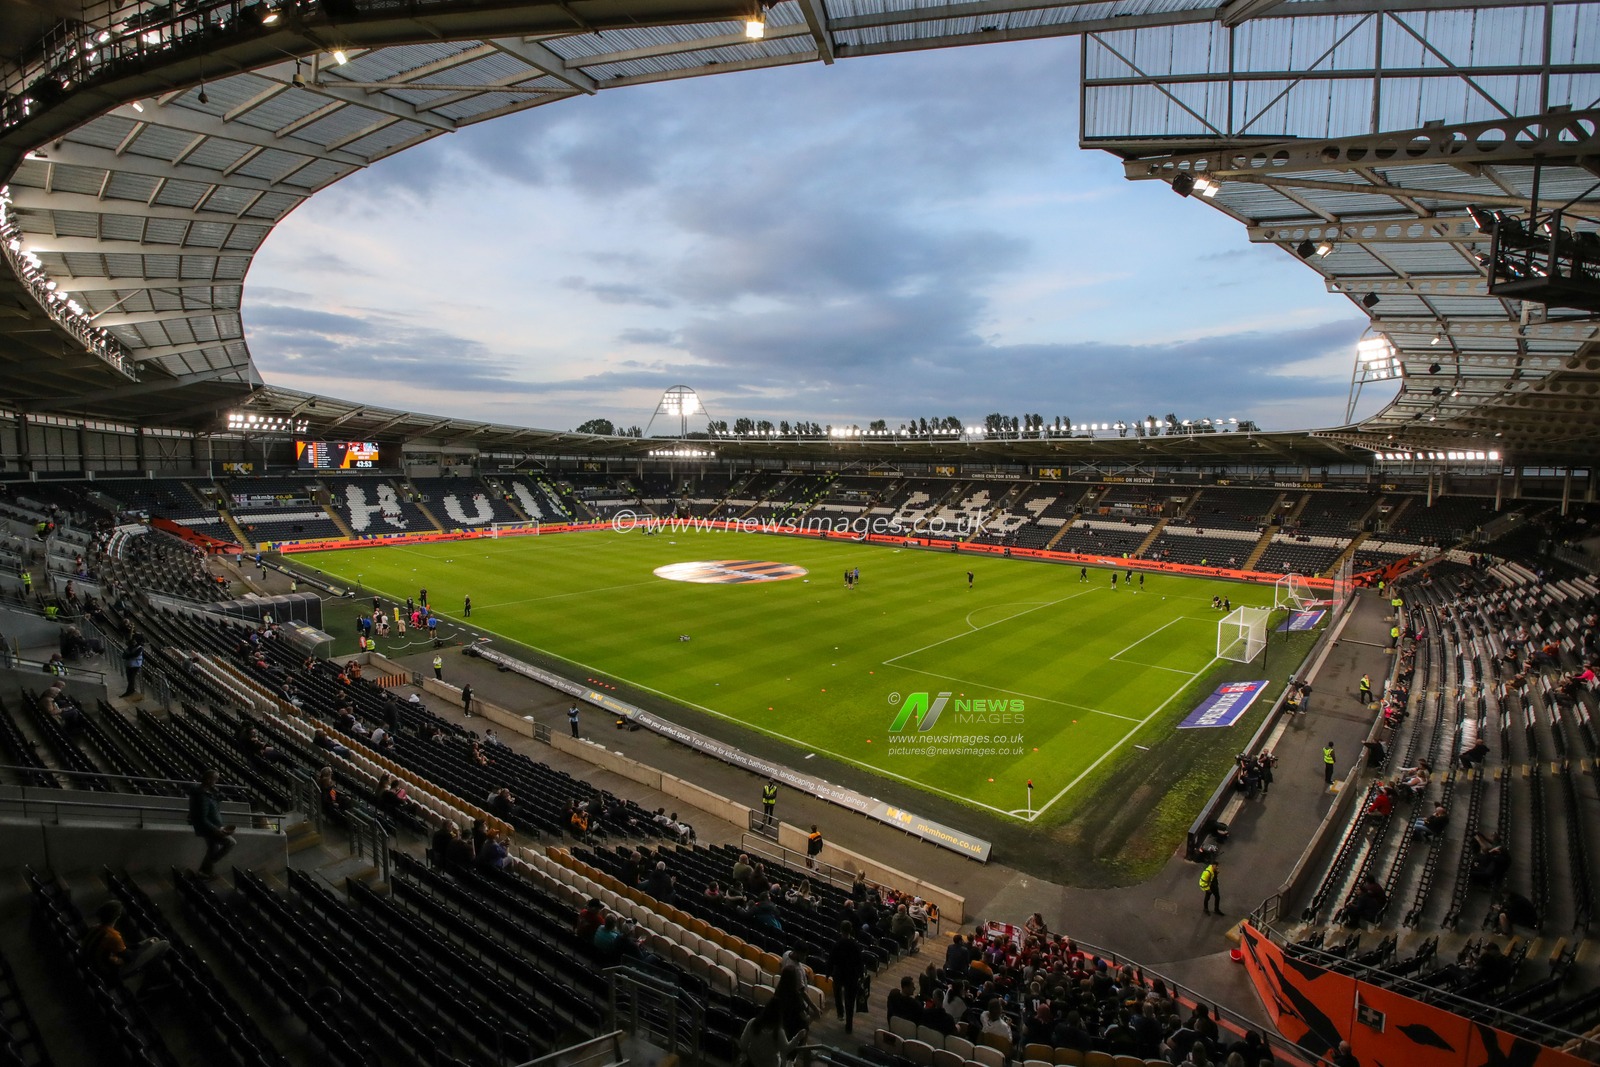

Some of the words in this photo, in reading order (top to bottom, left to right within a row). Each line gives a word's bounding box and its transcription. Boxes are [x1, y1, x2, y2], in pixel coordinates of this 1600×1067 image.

[223, 462, 253, 474] MKM
[936, 466, 955, 476] MKM
[1040, 468, 1062, 480] MKM
[639, 714, 654, 724] Create
[650, 721, 660, 732] your
[660, 724, 677, 736] perfect
[676, 732, 690, 741] space.
[692, 737, 704, 746] Your
[704, 741, 718, 751] home
[725, 750, 748, 765] kitchens,
[748, 759, 778, 776] bathrooms,
[779, 770, 816, 790] landscaping,
[816, 784, 830, 795] tiles
[831, 790, 844, 800] and
[843, 796, 868, 809] joinery.
[886, 806, 913, 824] MKM
[917, 824, 982, 854] mkmhome.co.uk
[1009, 955, 1016, 967] 7
